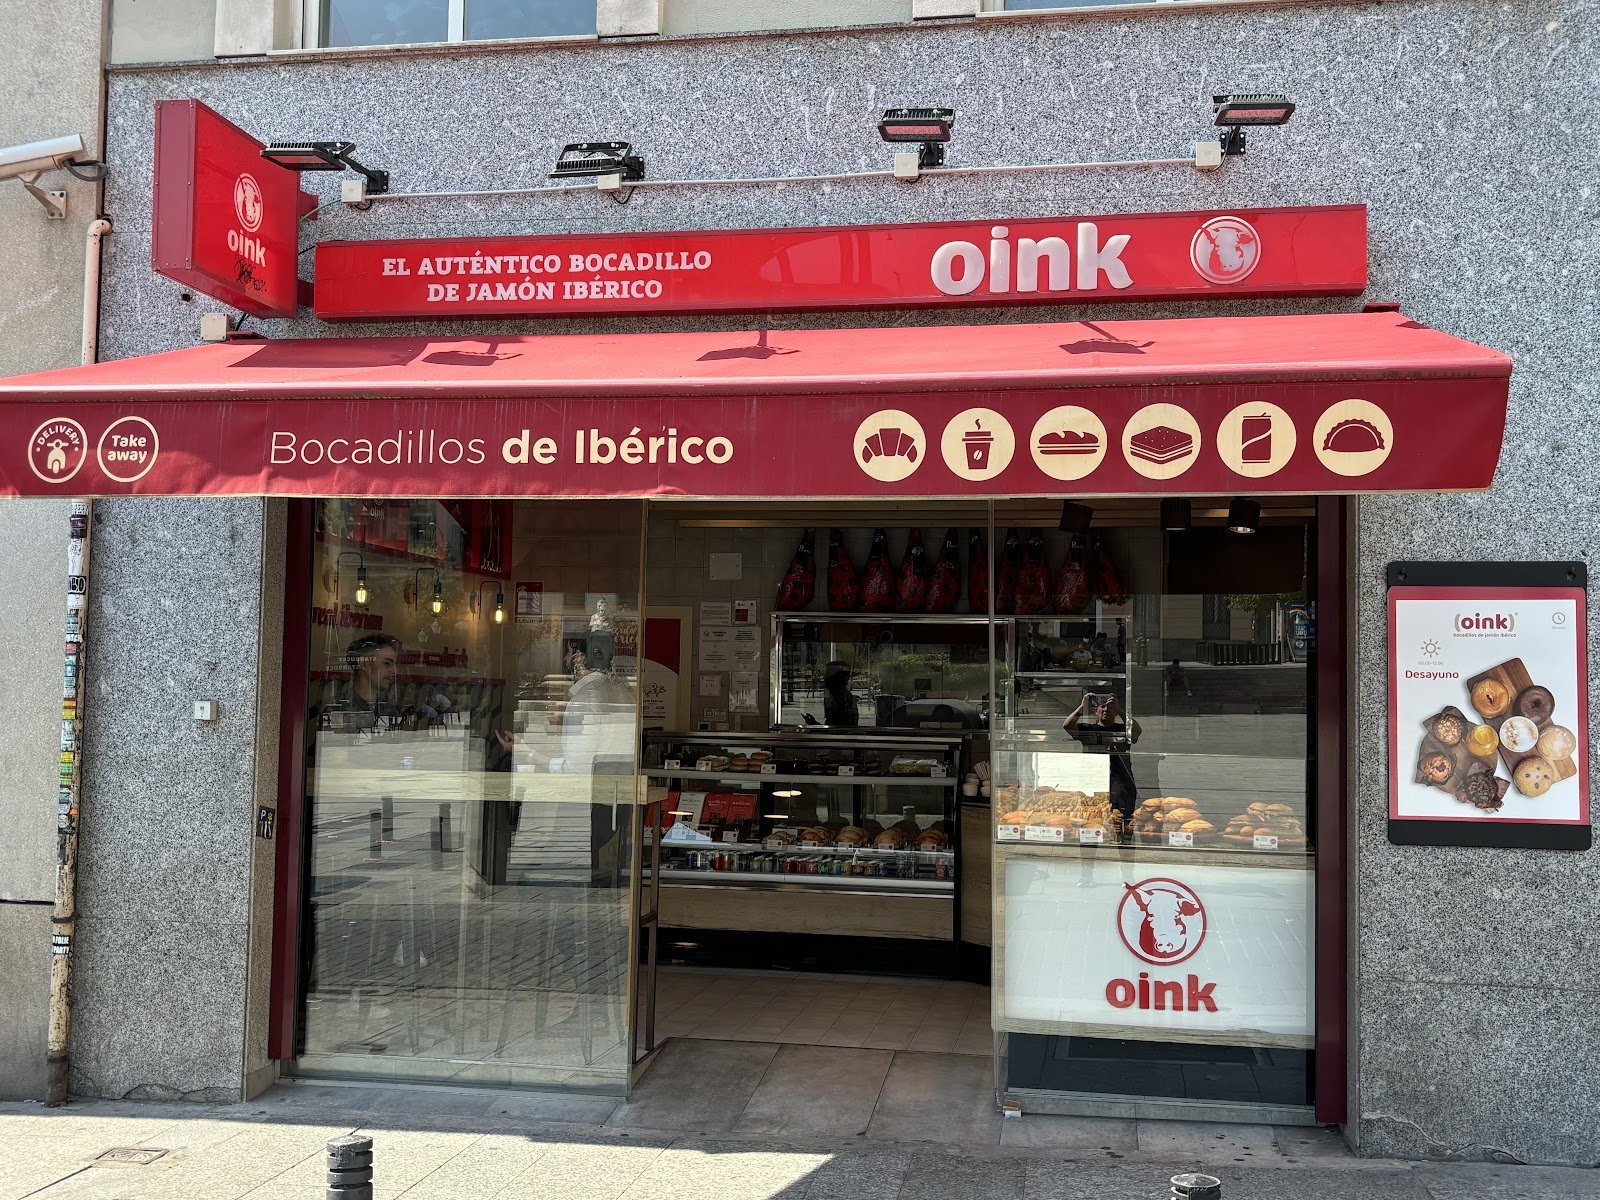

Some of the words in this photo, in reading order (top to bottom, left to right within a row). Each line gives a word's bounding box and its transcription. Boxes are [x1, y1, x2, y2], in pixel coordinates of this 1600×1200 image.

[227, 229, 267, 268] oink
[931, 222, 1134, 296] oink
[382, 258, 411, 276] EL
[417, 249, 562, 275] AUTÉNTICO
[568, 250, 712, 273] BOCADILLO
[427, 283, 460, 302] DE
[466, 275, 556, 302] JAMÓN
[562, 274, 663, 300] IBÉRICO
[37, 424, 81, 446] DELIVERY
[112, 434, 148, 448] Take
[270, 429, 486, 465] Bocadillos
[502, 429, 558, 464] de
[575, 425, 735, 464] Ibérico
[107, 450, 149, 464] away
[1405, 669, 1459, 681] Desayuno
[1105, 972, 1219, 1013] oink
